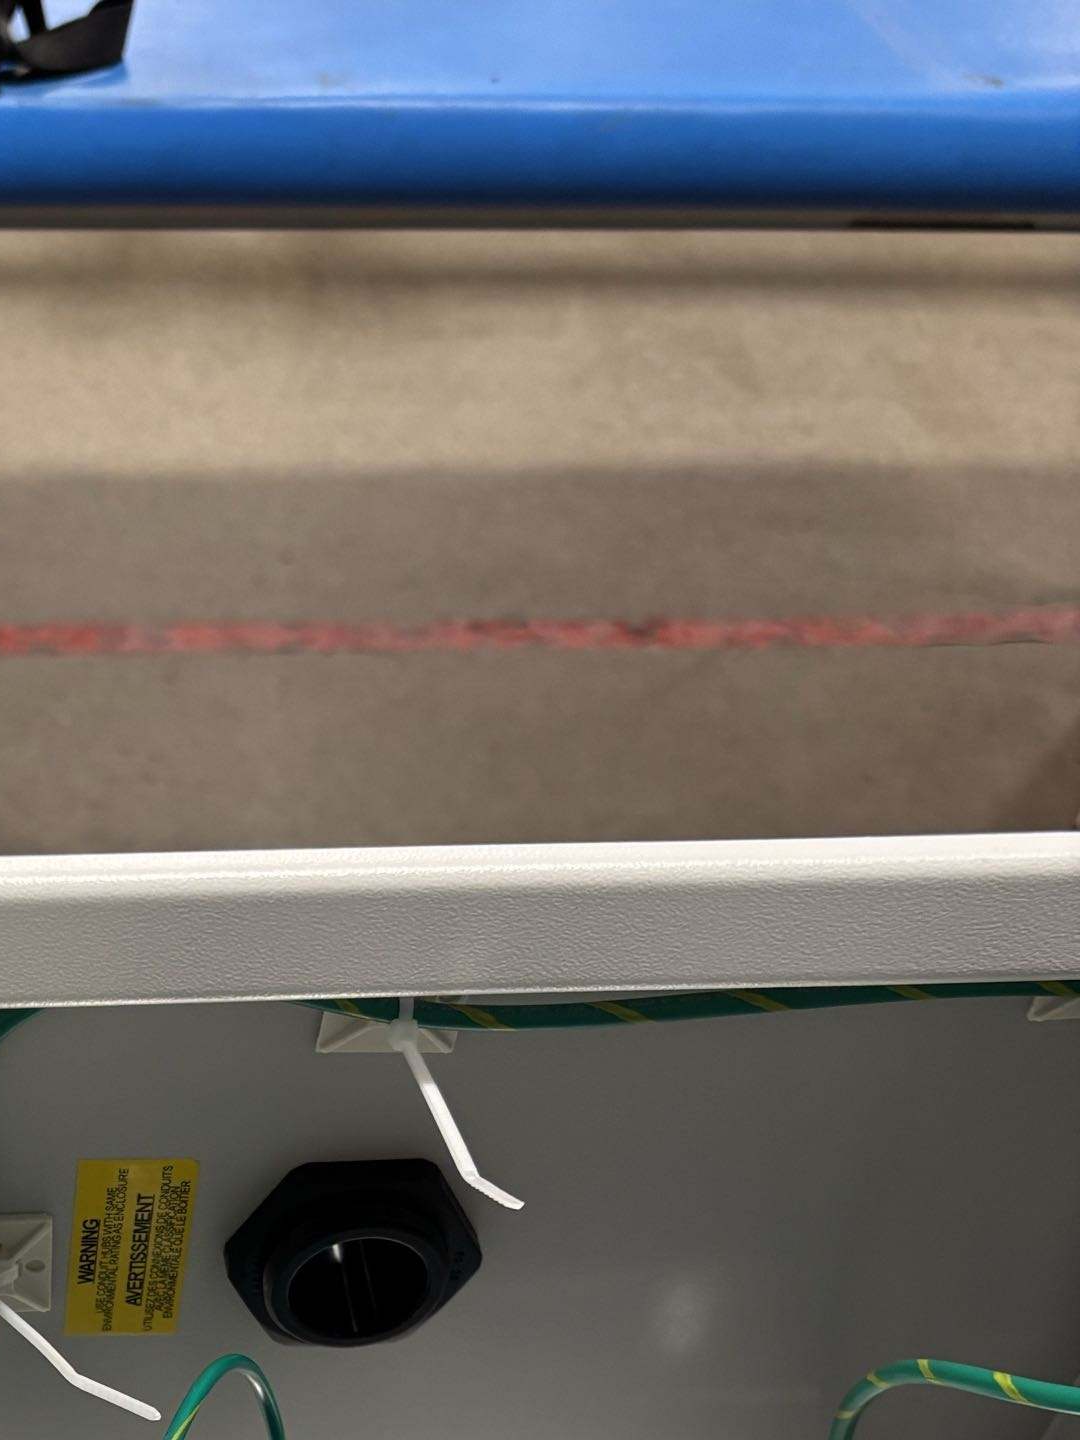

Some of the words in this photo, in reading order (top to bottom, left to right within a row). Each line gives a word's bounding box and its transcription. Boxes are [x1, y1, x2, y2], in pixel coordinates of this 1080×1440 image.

[113, 1169, 129, 1221] ENCLOSURE
[158, 1166, 173, 1211] CONDUITS
[76, 1218, 99, 1283] WARNING
[108, 1234, 122, 1264] RATING
[126, 1194, 154, 1306] AVERTISSEMENT
